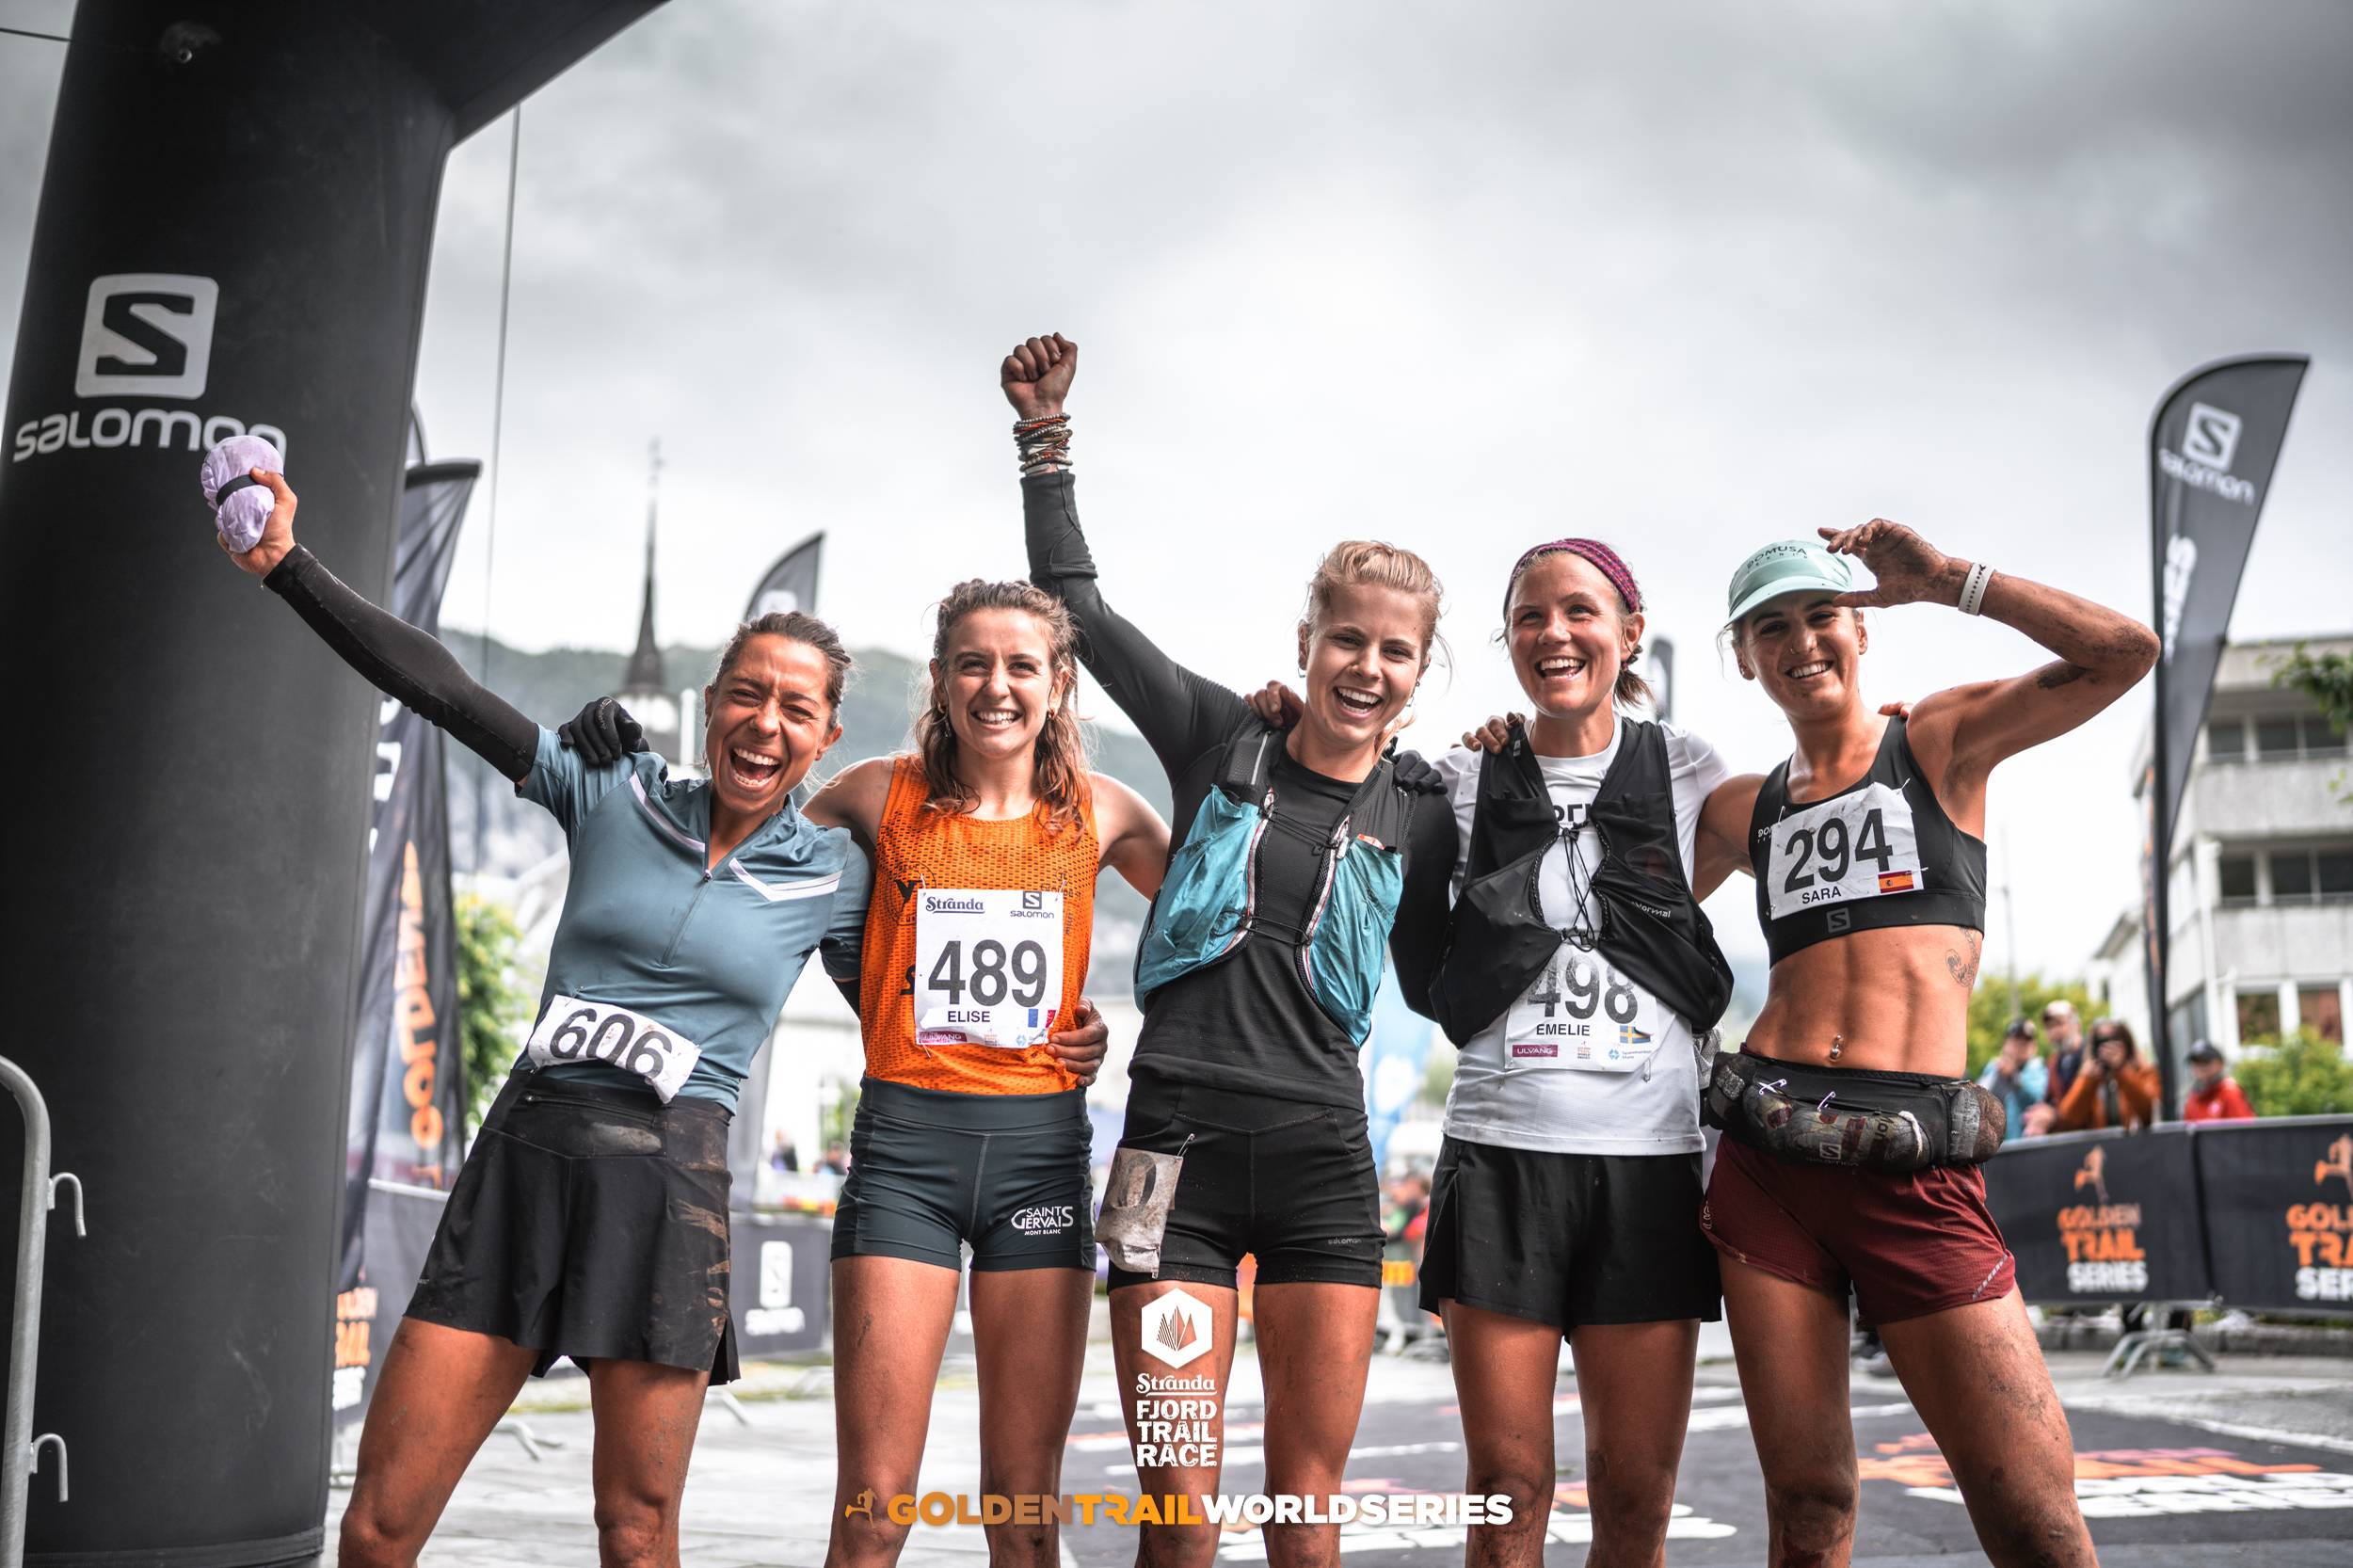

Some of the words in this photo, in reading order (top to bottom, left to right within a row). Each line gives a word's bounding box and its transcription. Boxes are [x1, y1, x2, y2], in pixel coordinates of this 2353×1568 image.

[1747, 546, 1807, 569] DOMUSA
[1784, 808, 1894, 894] 294
[925, 896, 985, 913] Stranda
[1801, 886, 1842, 905] SARA
[1010, 910, 1055, 920] salomon
[928, 939, 1048, 1007] 489
[1527, 954, 1639, 1025] 498
[947, 1011, 991, 1023] ELISE
[1536, 1023, 1591, 1036] EMELIE
[550, 1007, 673, 1080] 606
[2060, 1228, 2146, 1263] TRAIL
[2067, 1261, 2149, 1293] SERIES
